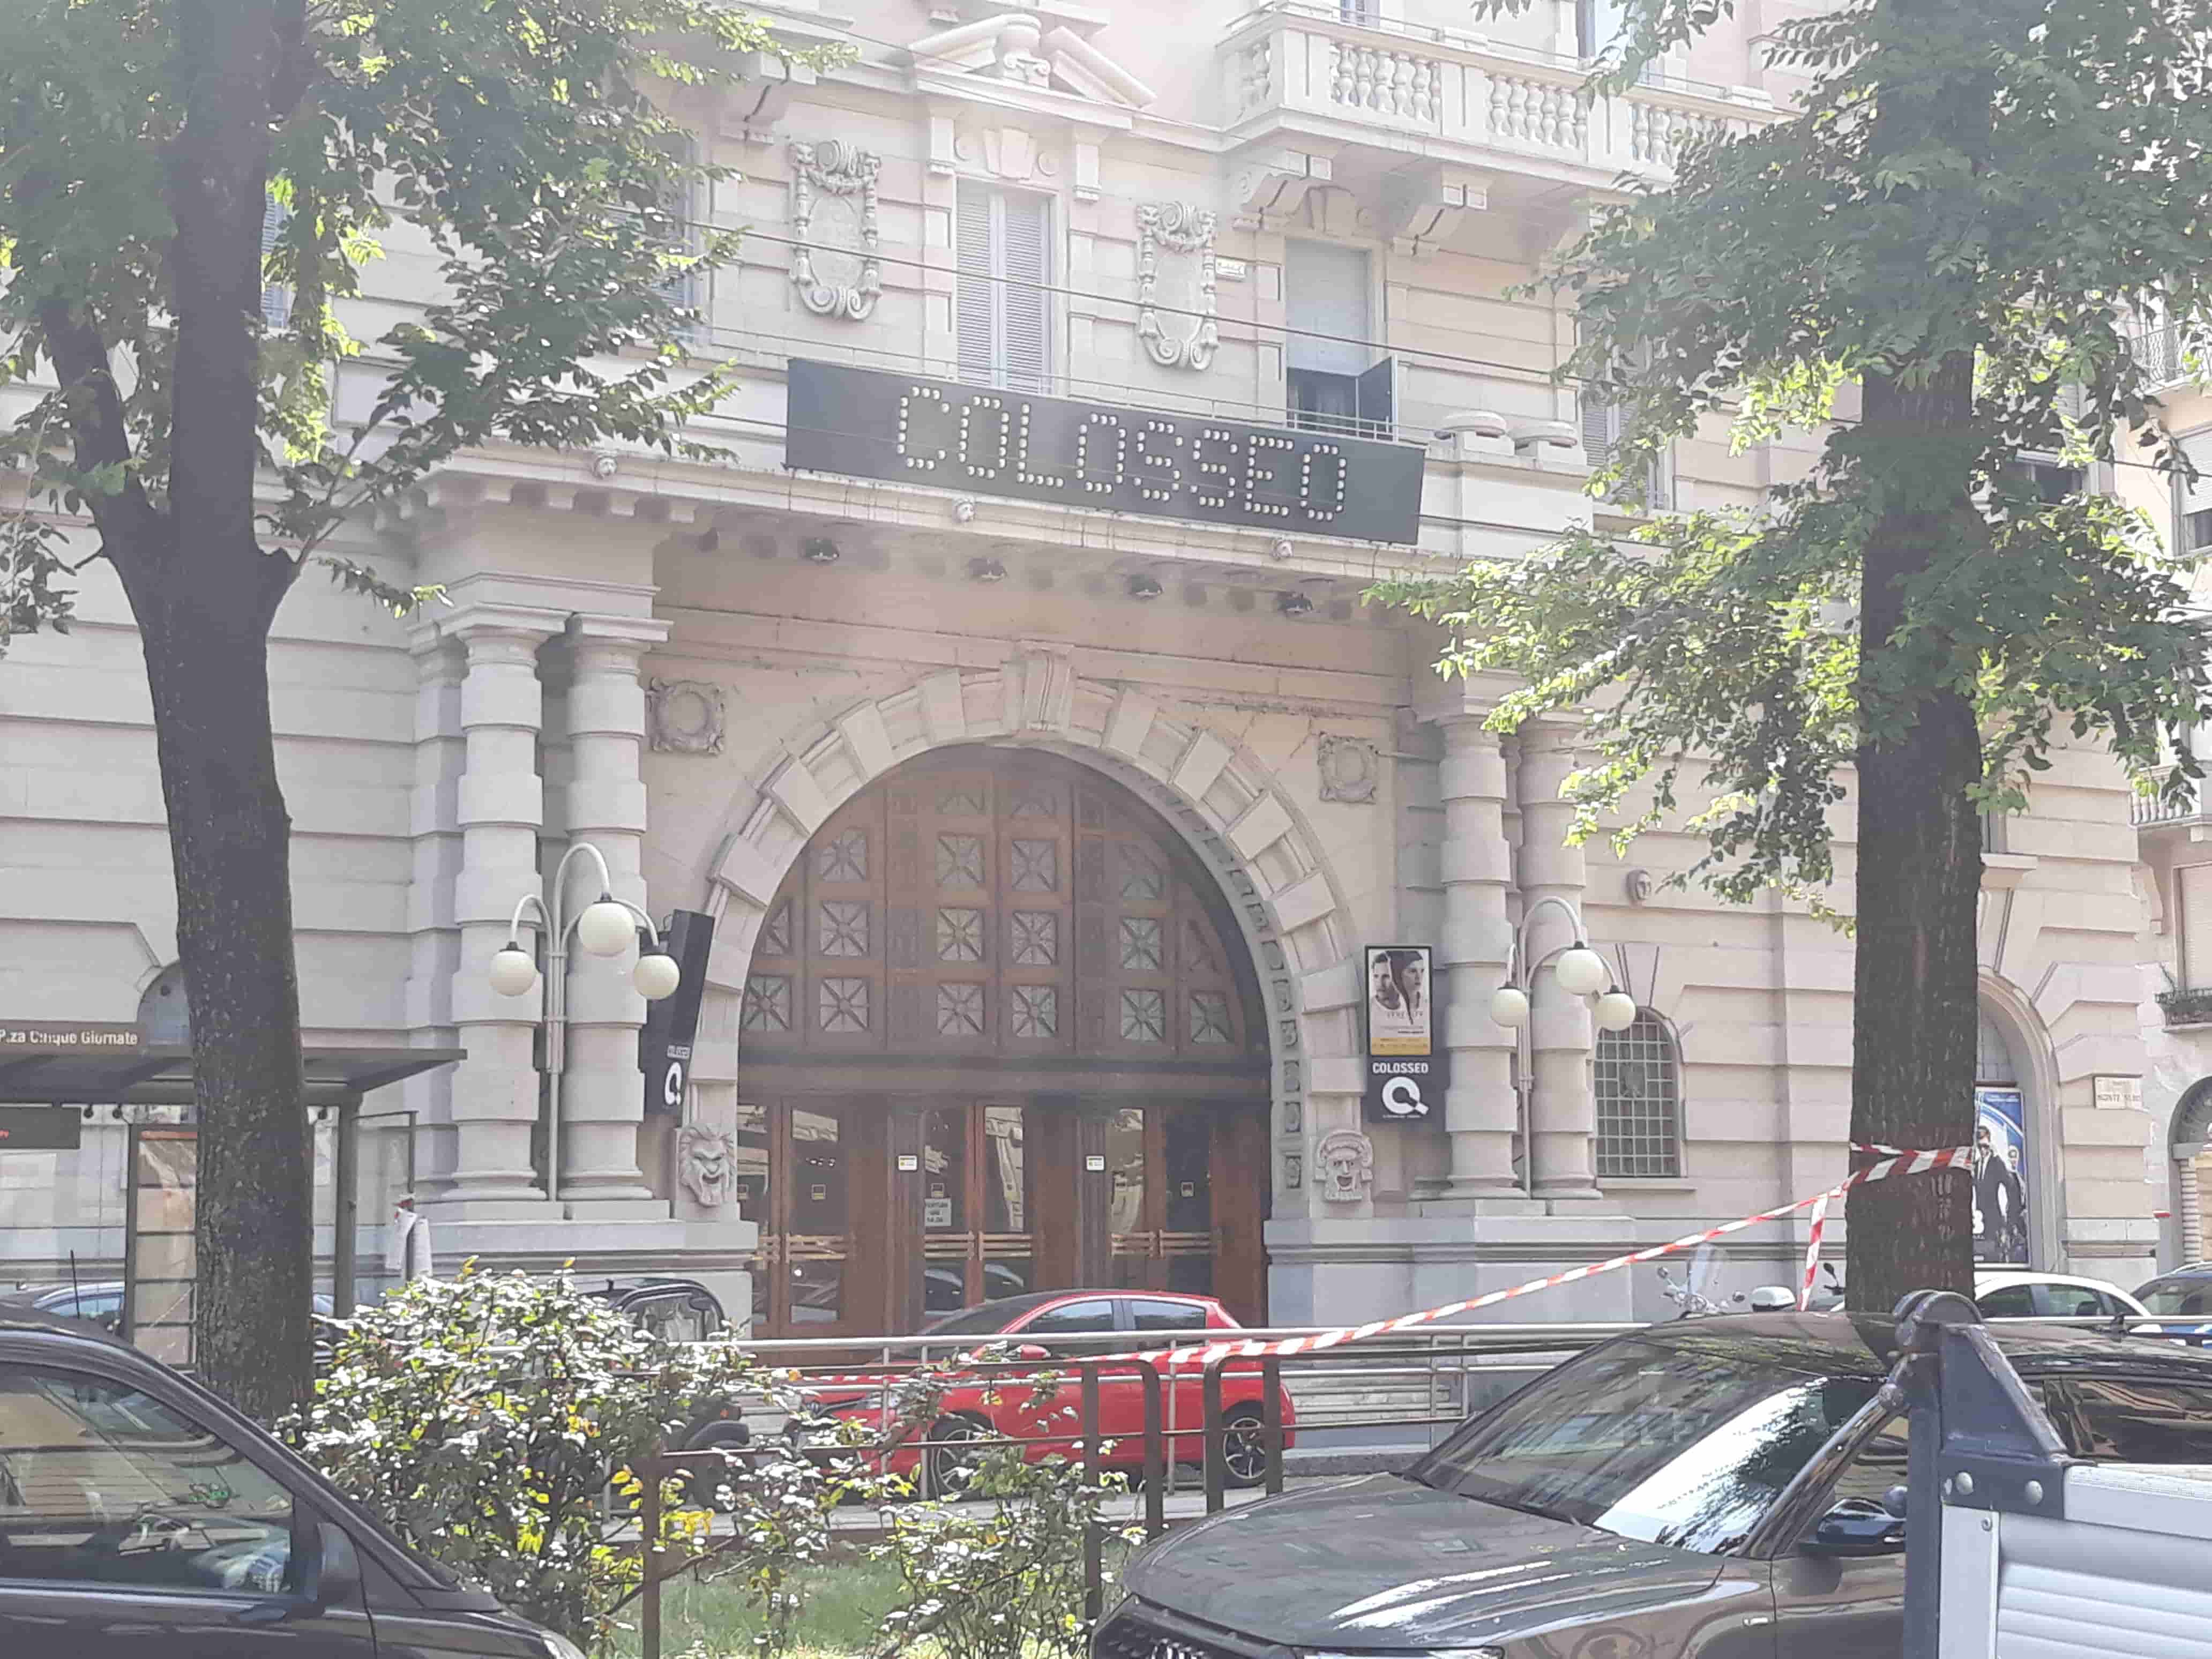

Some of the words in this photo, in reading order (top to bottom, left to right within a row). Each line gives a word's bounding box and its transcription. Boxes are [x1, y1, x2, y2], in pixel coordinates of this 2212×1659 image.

[896, 385, 1347, 521] COLOSSEO
[29, 1030, 77, 1047] Cinque
[81, 1030, 138, 1045] Giornate
[1372, 1062, 1429, 1074] COLOSSEO
